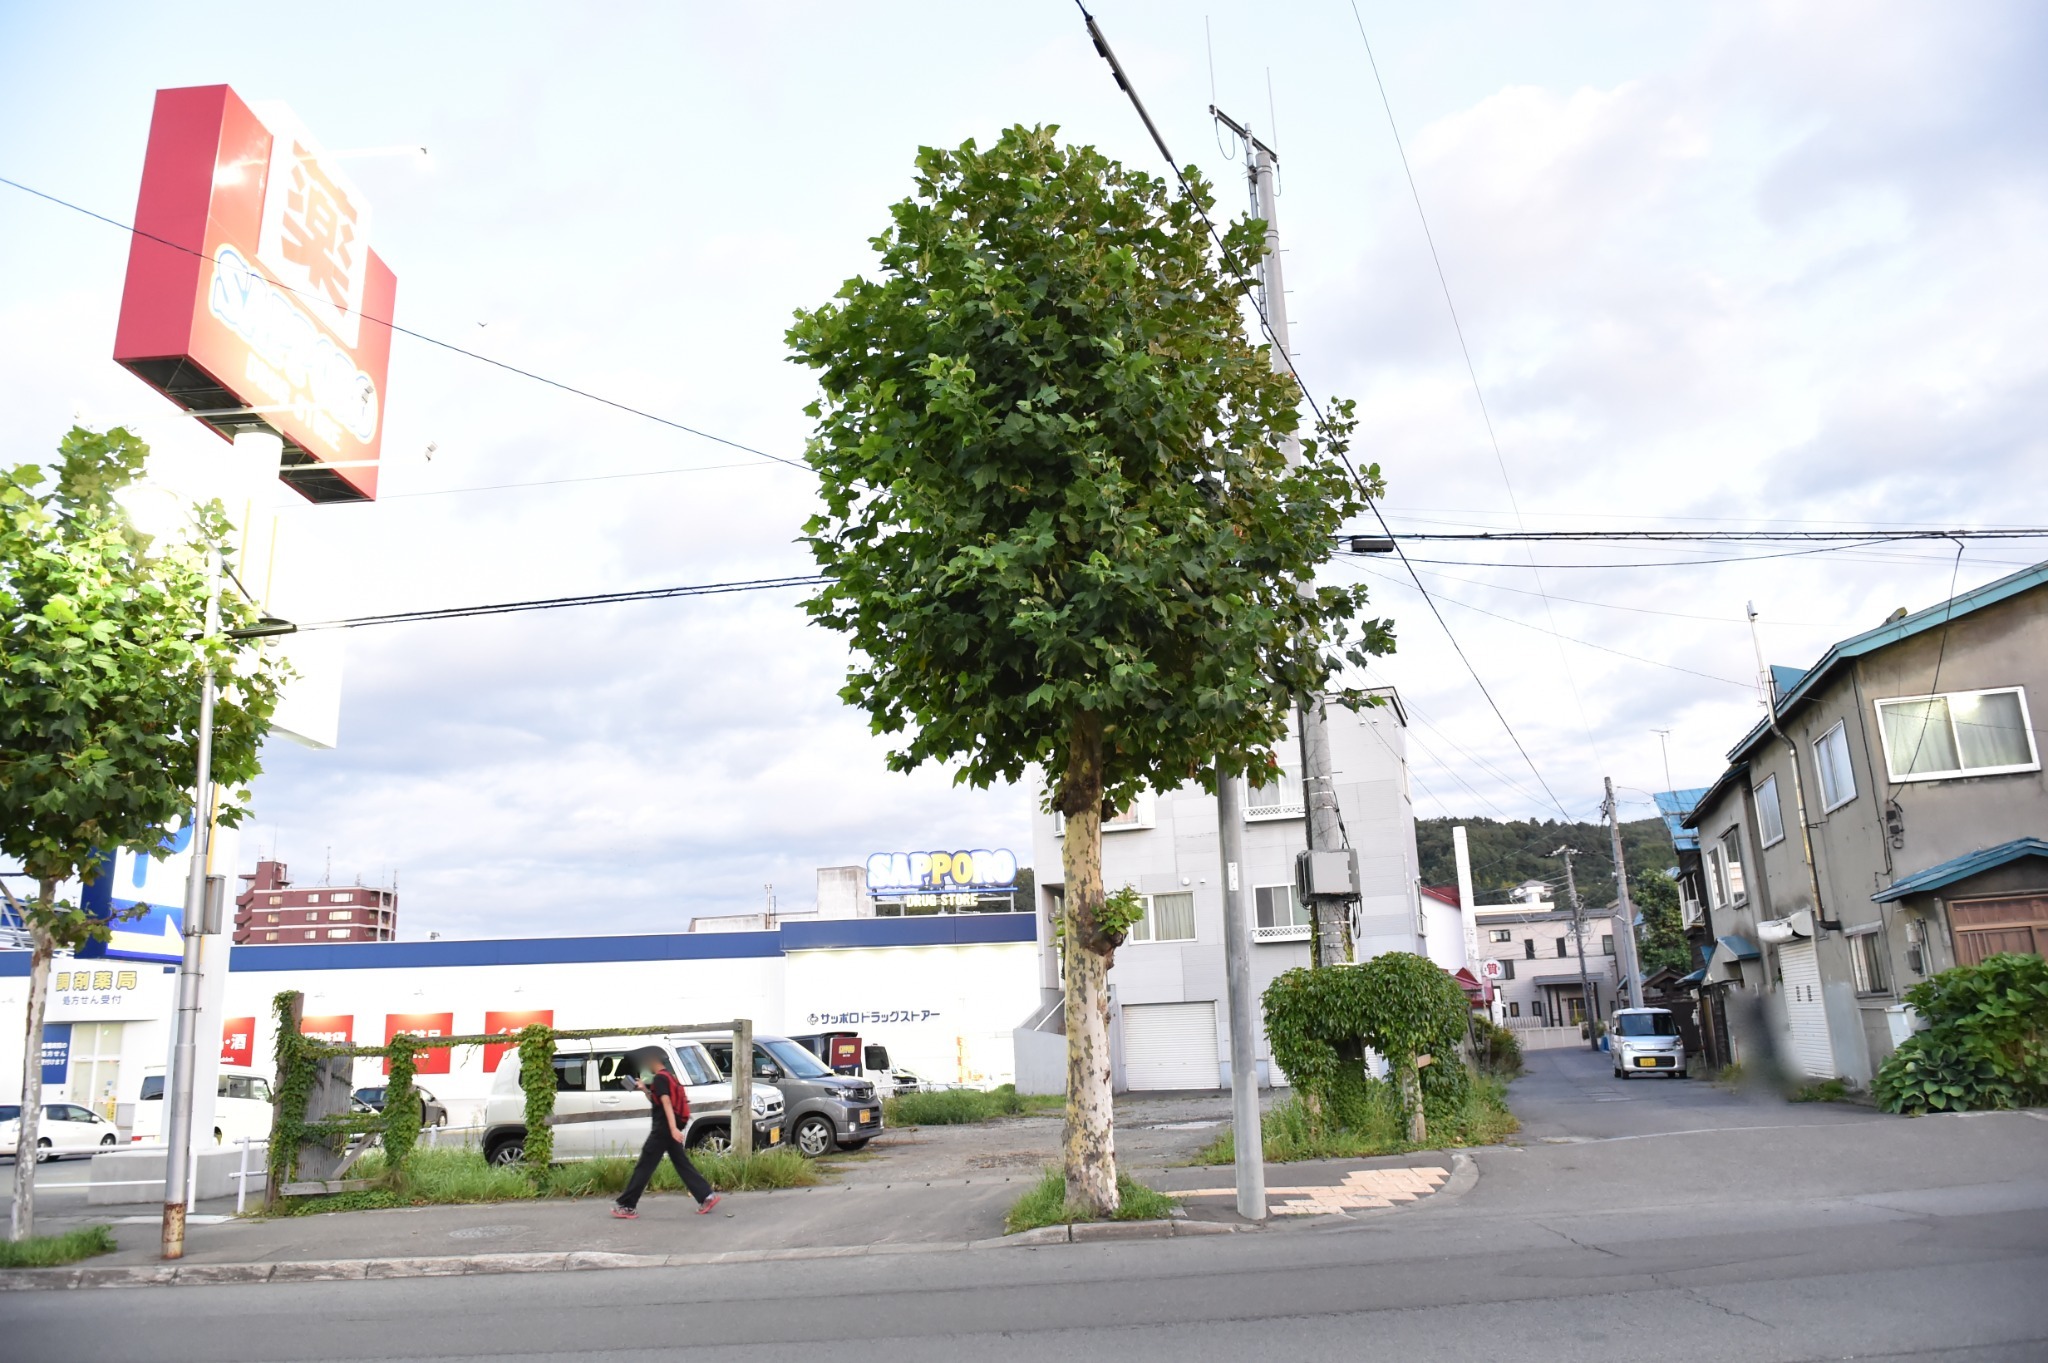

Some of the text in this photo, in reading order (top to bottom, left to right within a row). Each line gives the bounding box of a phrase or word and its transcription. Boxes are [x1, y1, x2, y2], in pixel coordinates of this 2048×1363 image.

[281, 138, 357, 317] 薬
[867, 848, 1017, 889] SAPPORO
[906, 892, 979, 908] DRUG STORE
[55, 970, 138, 992] 調剤薬局
[62, 994, 122, 1006] 処方せん受付
[820, 1009, 941, 1025] サッポロドラッグストアー
